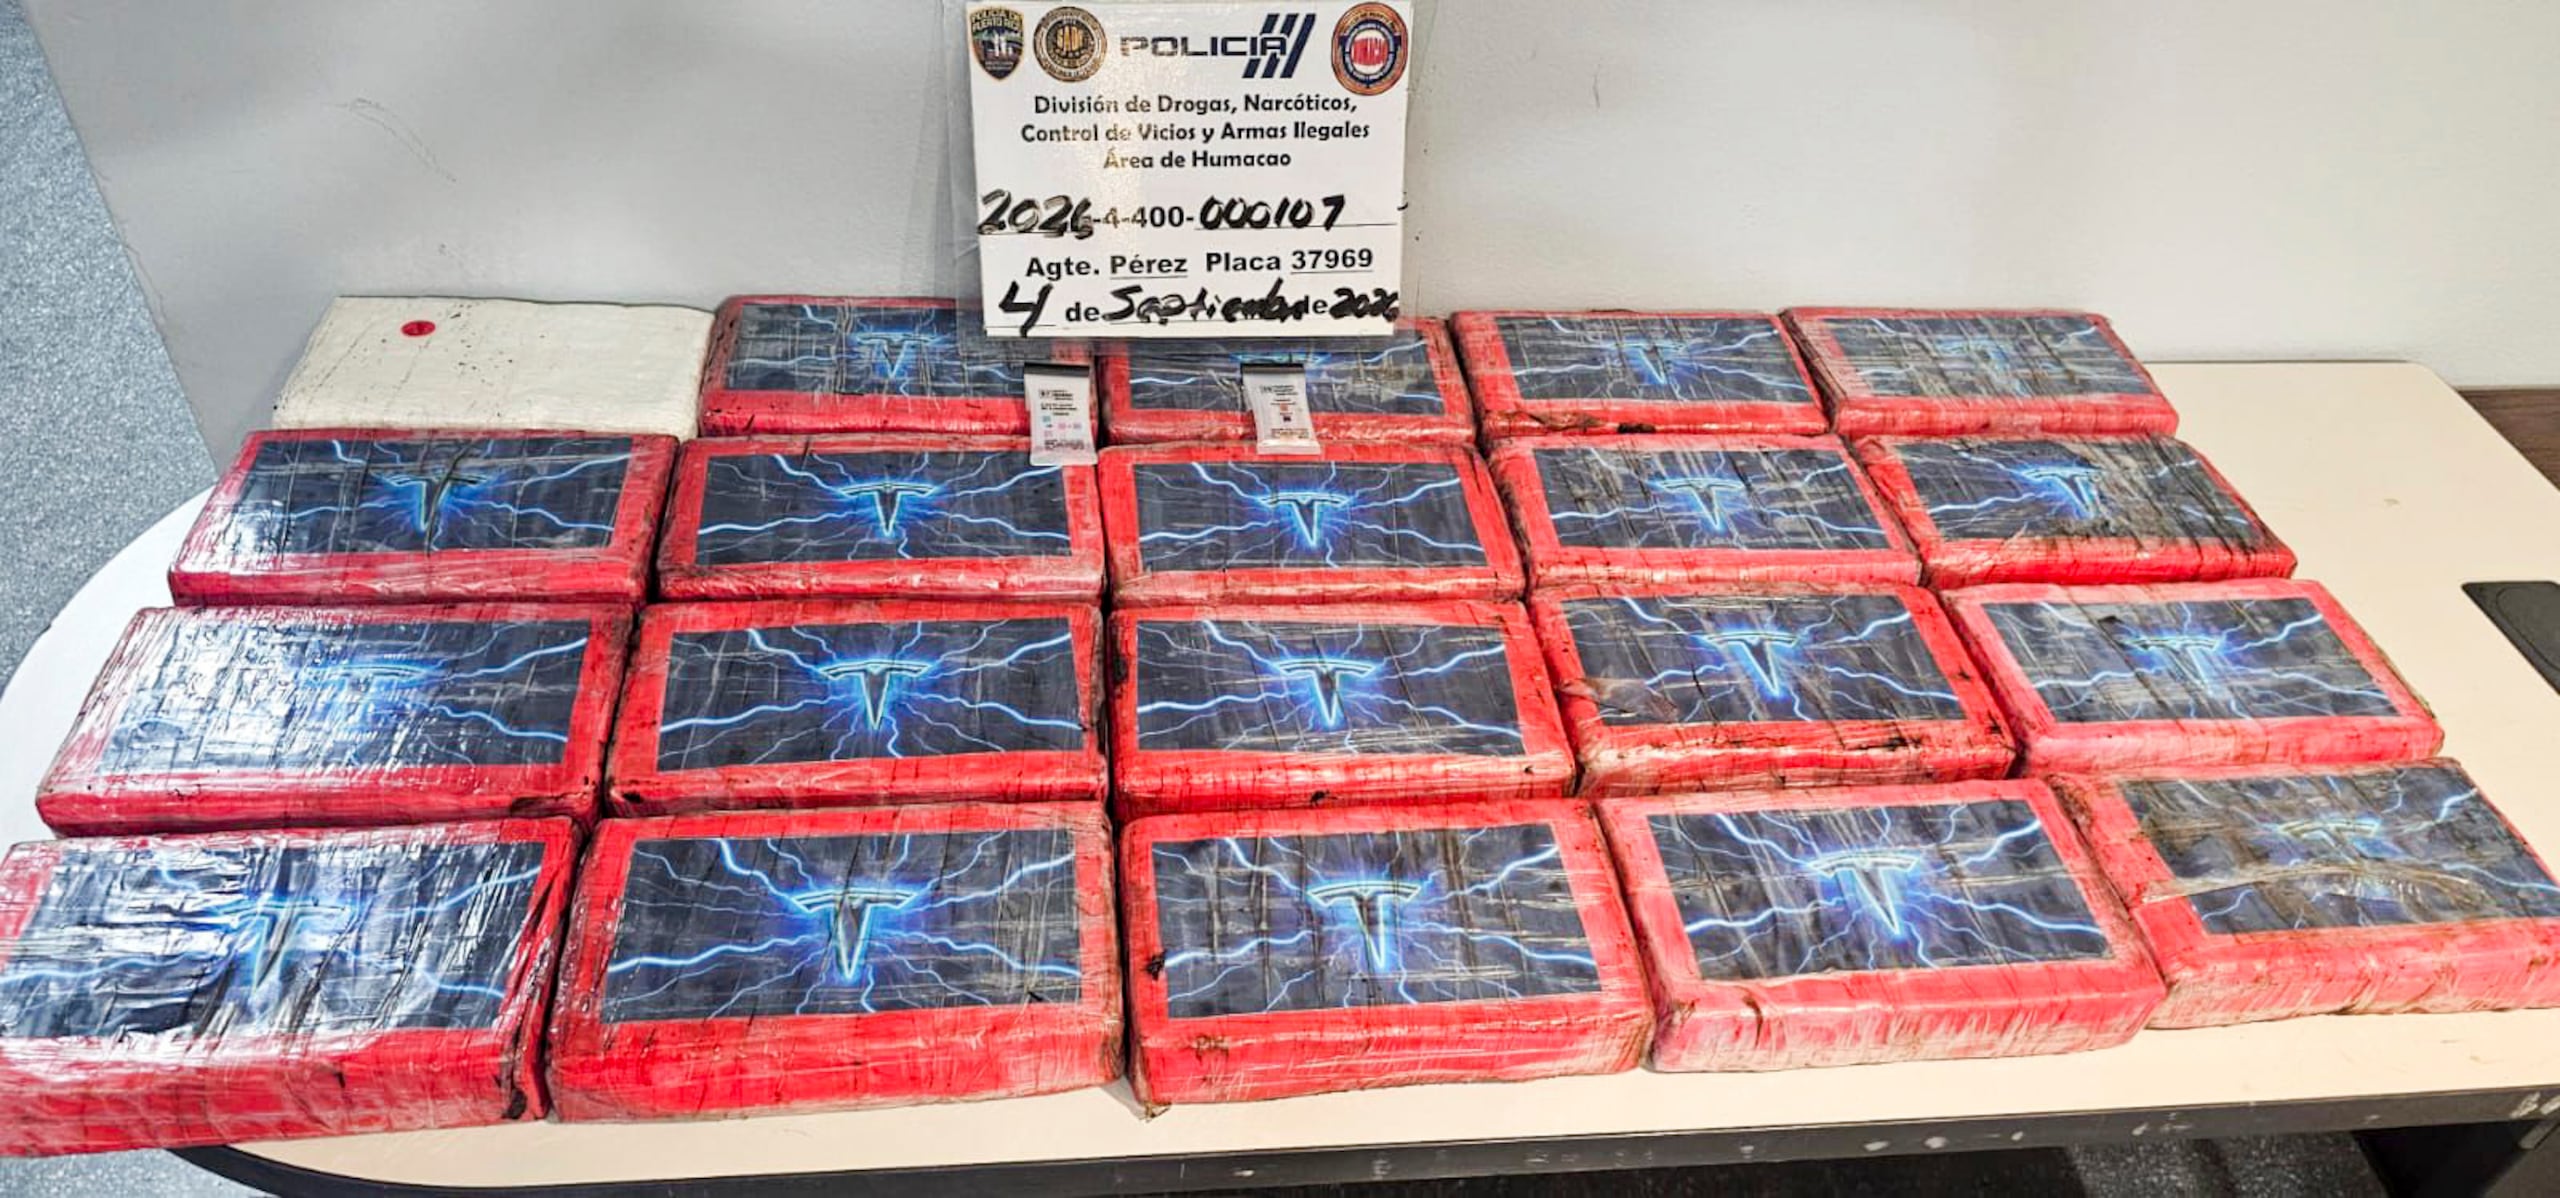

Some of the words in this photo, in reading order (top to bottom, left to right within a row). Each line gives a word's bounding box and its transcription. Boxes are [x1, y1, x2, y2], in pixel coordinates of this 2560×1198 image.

[1034, 95, 1118, 114] División
[1125, 95, 1151, 113] de
[1158, 94, 1237, 115] Drogas,
[1244, 93, 1357, 114] Narcóticos,
[1021, 124, 1098, 142] Control
[1105, 124, 1131, 142] de
[1138, 123, 1196, 142] Vicios
[1202, 126, 1215, 144] y
[1221, 122, 1287, 140] Armas
[1294, 121, 1370, 141] Ilegales
[1104, 147, 1154, 169] Área
[1160, 150, 1186, 168] de
[1192, 150, 1292, 168] Humacao
[1026, 256, 1100, 282] Agte.
[1110, 254, 1188, 275] Pérez
[1206, 252, 1281, 272] Placa
[1291, 248, 1373, 270] 37969
[998, 281, 1053, 337] 4
[1065, 302, 1100, 323] de
